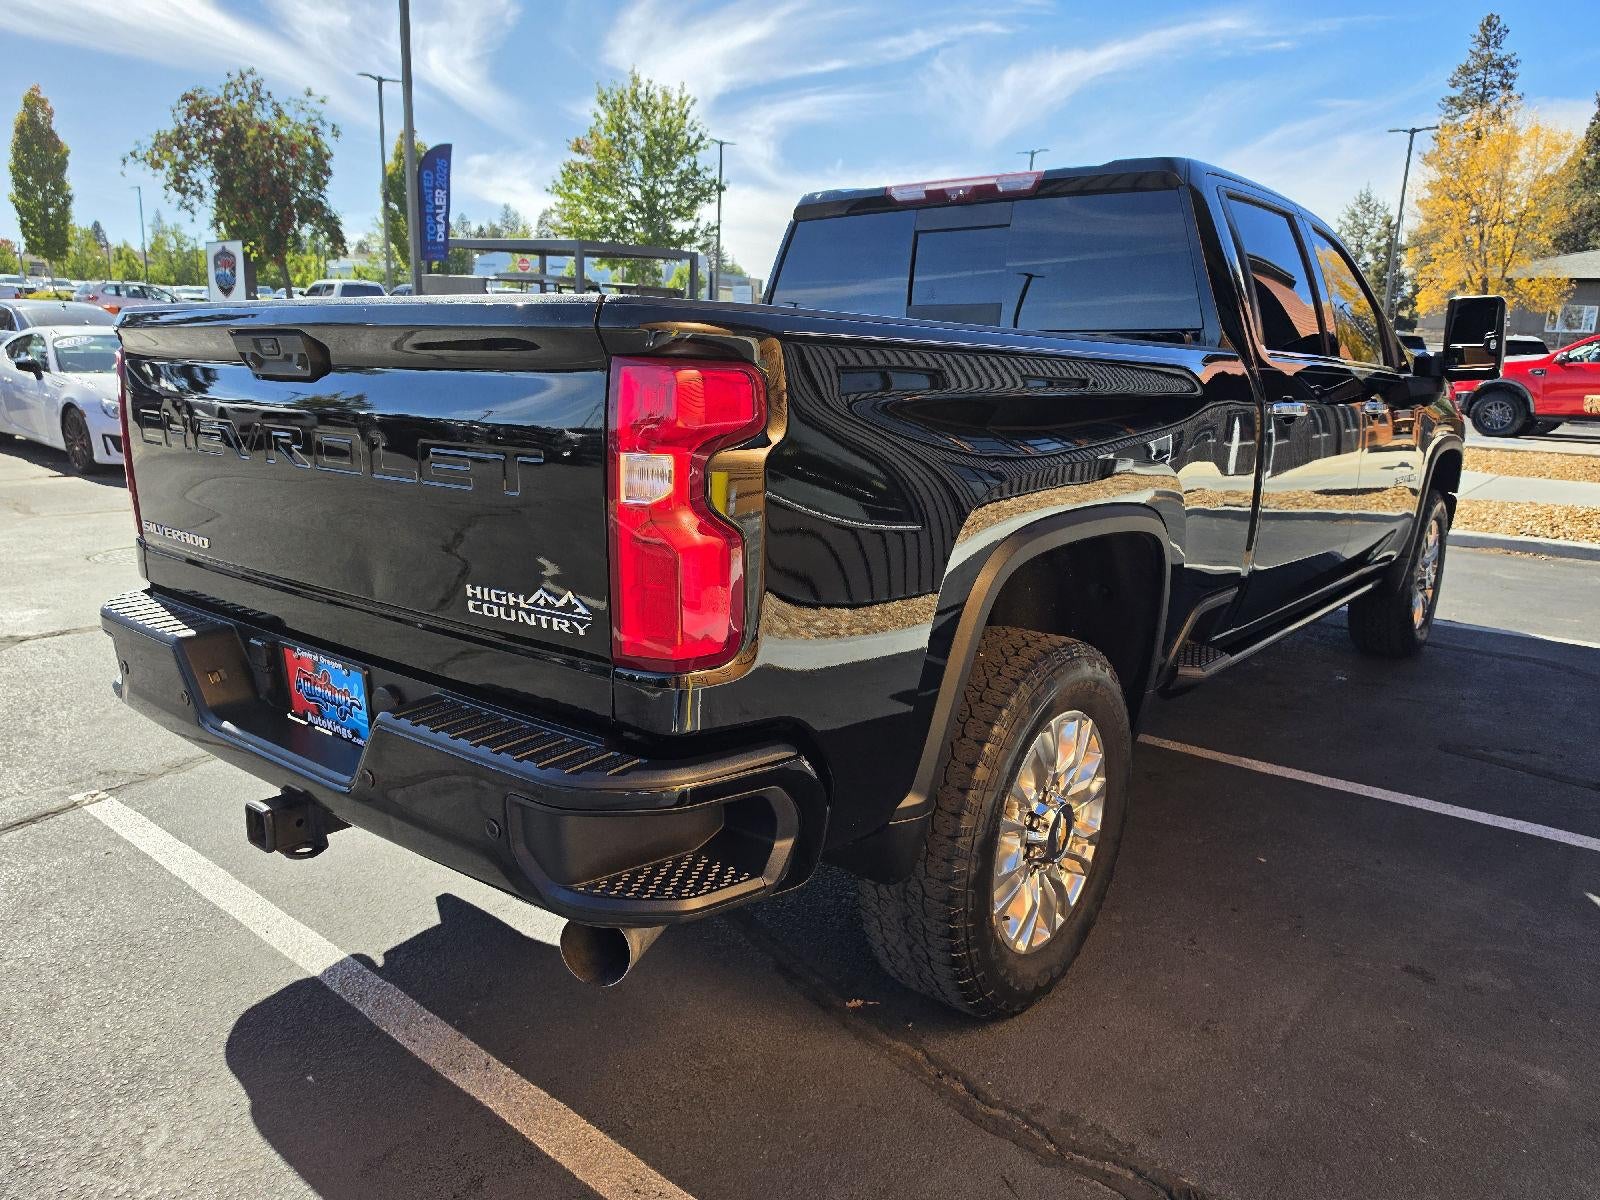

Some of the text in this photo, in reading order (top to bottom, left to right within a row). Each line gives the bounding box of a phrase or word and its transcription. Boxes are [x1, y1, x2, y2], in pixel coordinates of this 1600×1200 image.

[423, 170, 435, 213] RATED
[426, 214, 437, 242] TOP
[435, 188, 447, 243] DEALER
[139, 402, 545, 497] CHEVROLET
[143, 520, 211, 549] SILVERADO
[466, 584, 526, 608] HIGH
[467, 600, 592, 636] COUNTRY
[320, 655, 343, 670] Oregon
